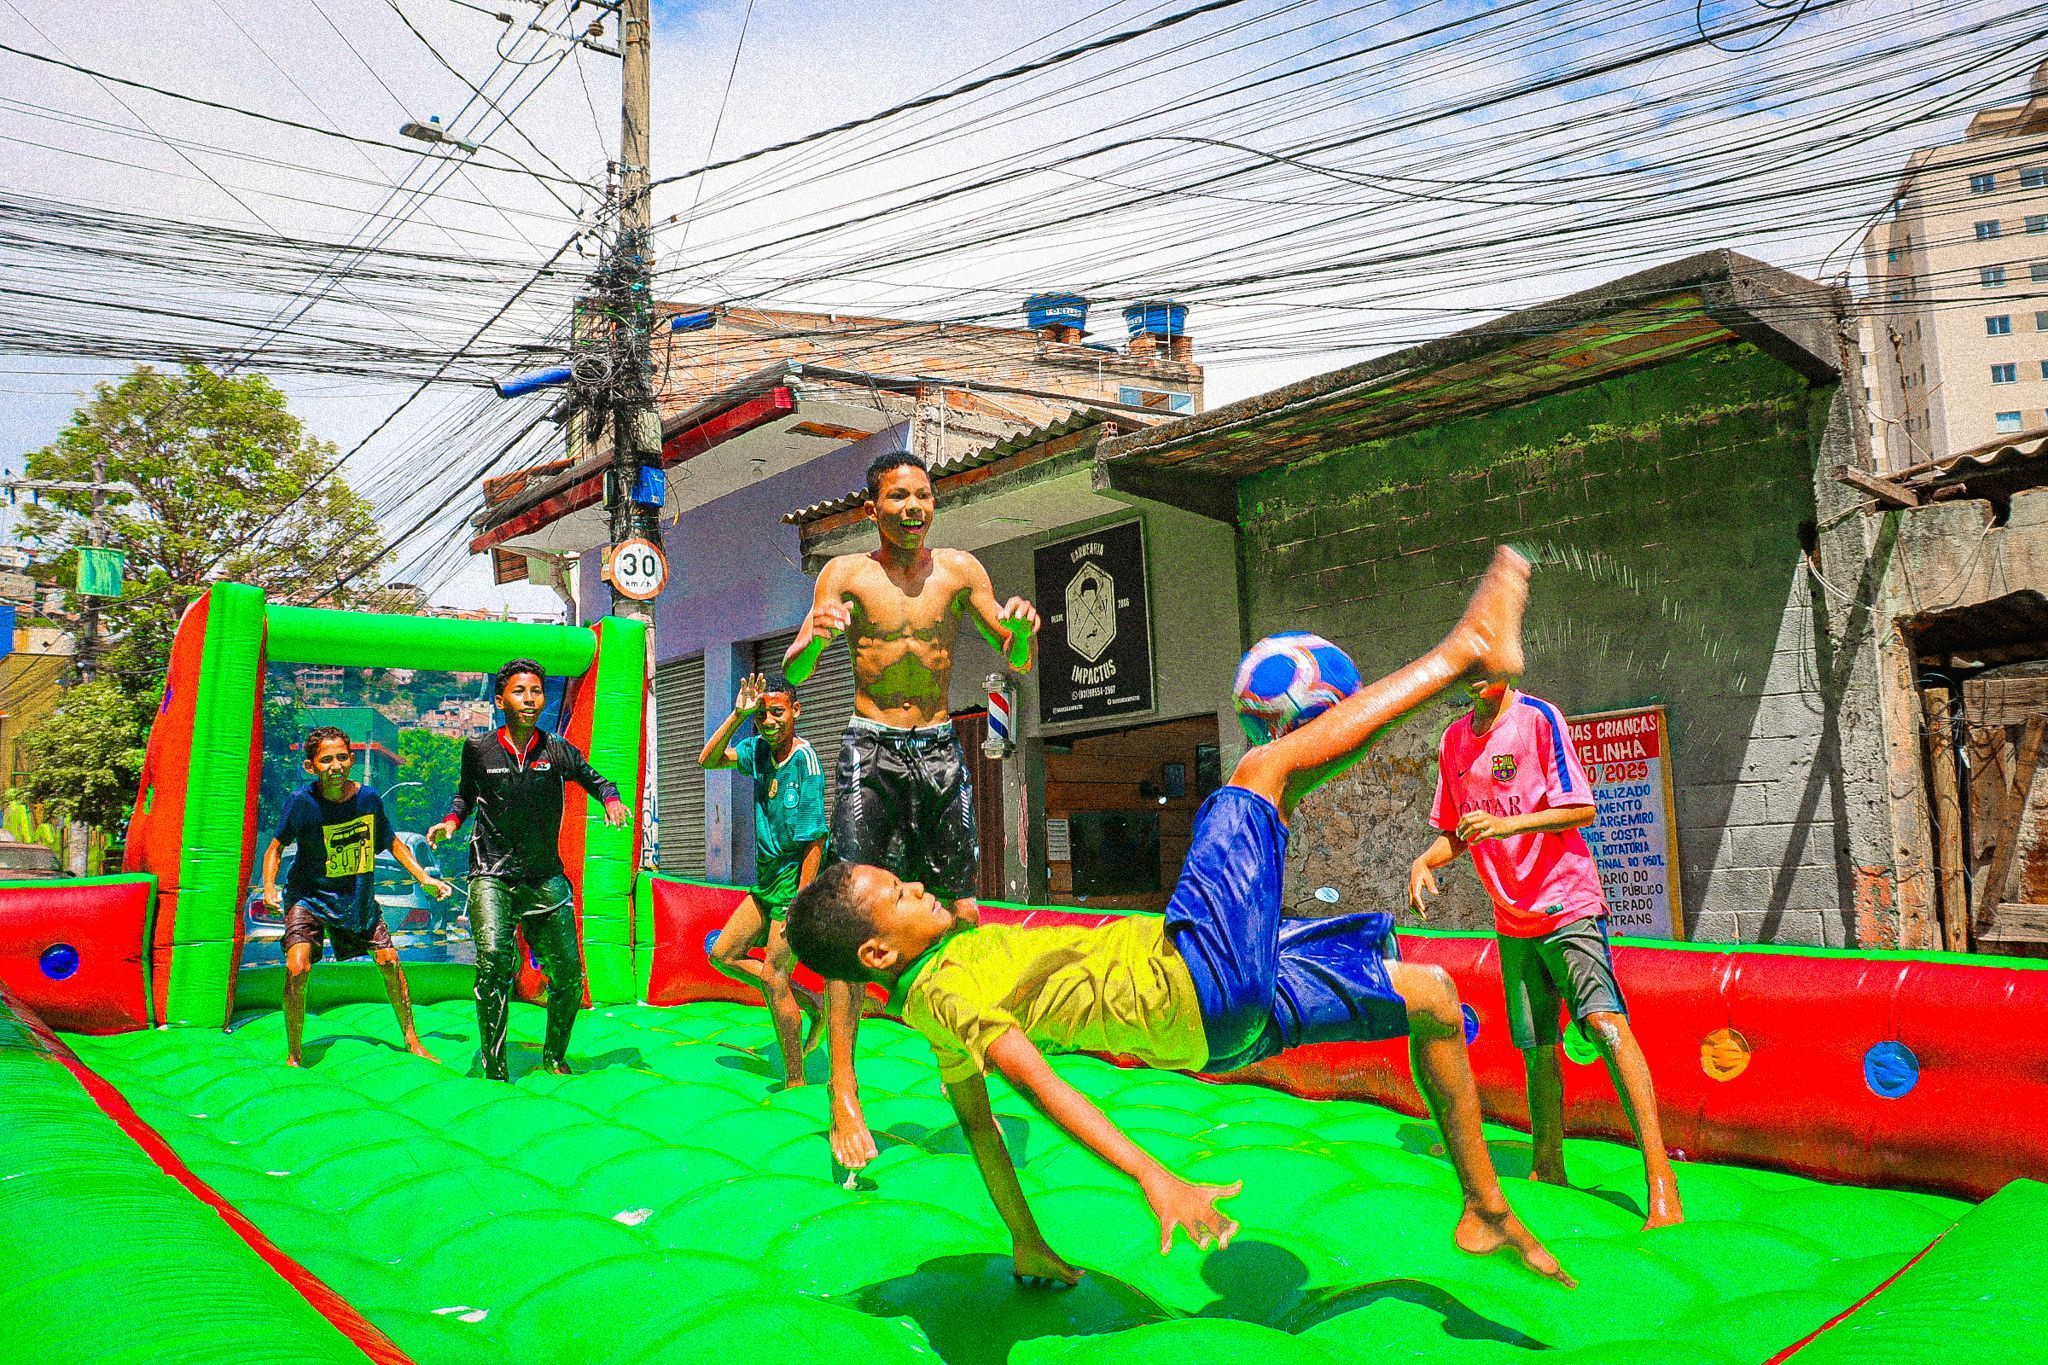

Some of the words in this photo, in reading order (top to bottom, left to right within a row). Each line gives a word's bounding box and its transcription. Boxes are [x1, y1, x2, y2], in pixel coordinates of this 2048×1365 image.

[1070, 542, 1104, 563] BARBEARIA
[622, 553, 655, 577] 30
[625, 580, 652, 588] km/h
[1071, 659, 1116, 685] IMPACTUS
[1596, 714, 1657, 738] CRIANÇAS
[1600, 811, 1654, 828] ARGEMIRO
[1611, 828, 1647, 841] COSTA
[330, 846, 371, 870] SURF
[1597, 858, 1624, 870] FINAL
[1633, 870, 1648, 883] DO
[1622, 883, 1663, 897] PÚBLICO
